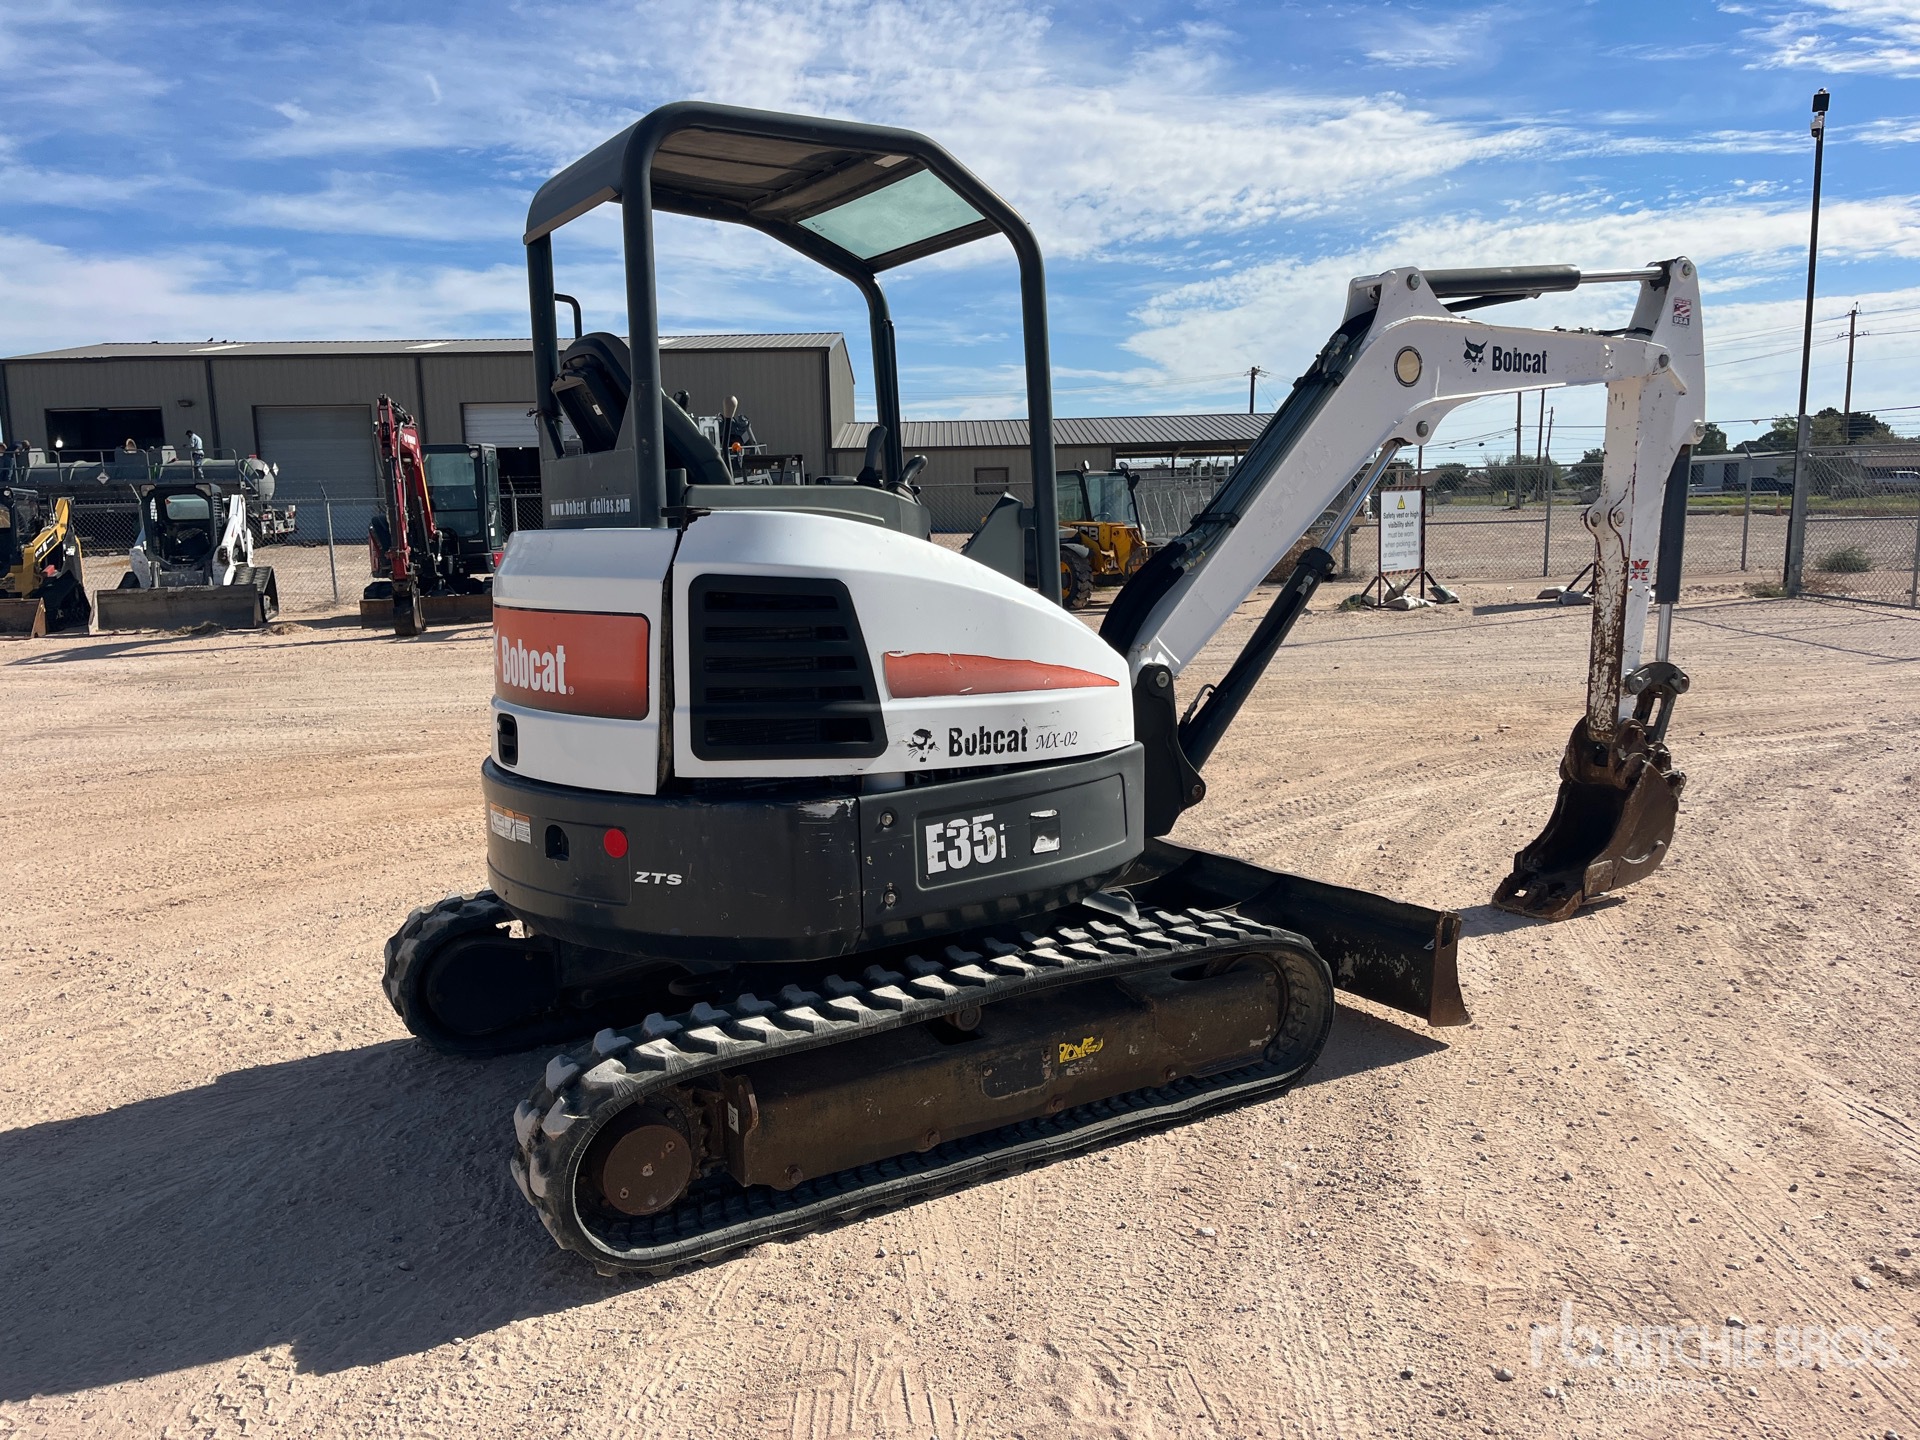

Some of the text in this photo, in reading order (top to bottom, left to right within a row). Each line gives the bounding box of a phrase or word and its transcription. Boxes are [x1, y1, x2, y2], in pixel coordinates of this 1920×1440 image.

[1673, 317, 1689, 325] USA
[1492, 345, 1547, 374] Bobcat
[1383, 512, 1396, 520] Safety
[1410, 510, 1419, 519] high
[1388, 520, 1414, 529] visibility shirt
[1070, 525, 1099, 541] CB
[501, 636, 566, 695] Bobcat
[949, 726, 1078, 757] Bobcat MX-02
[634, 871, 682, 886] ZTS
